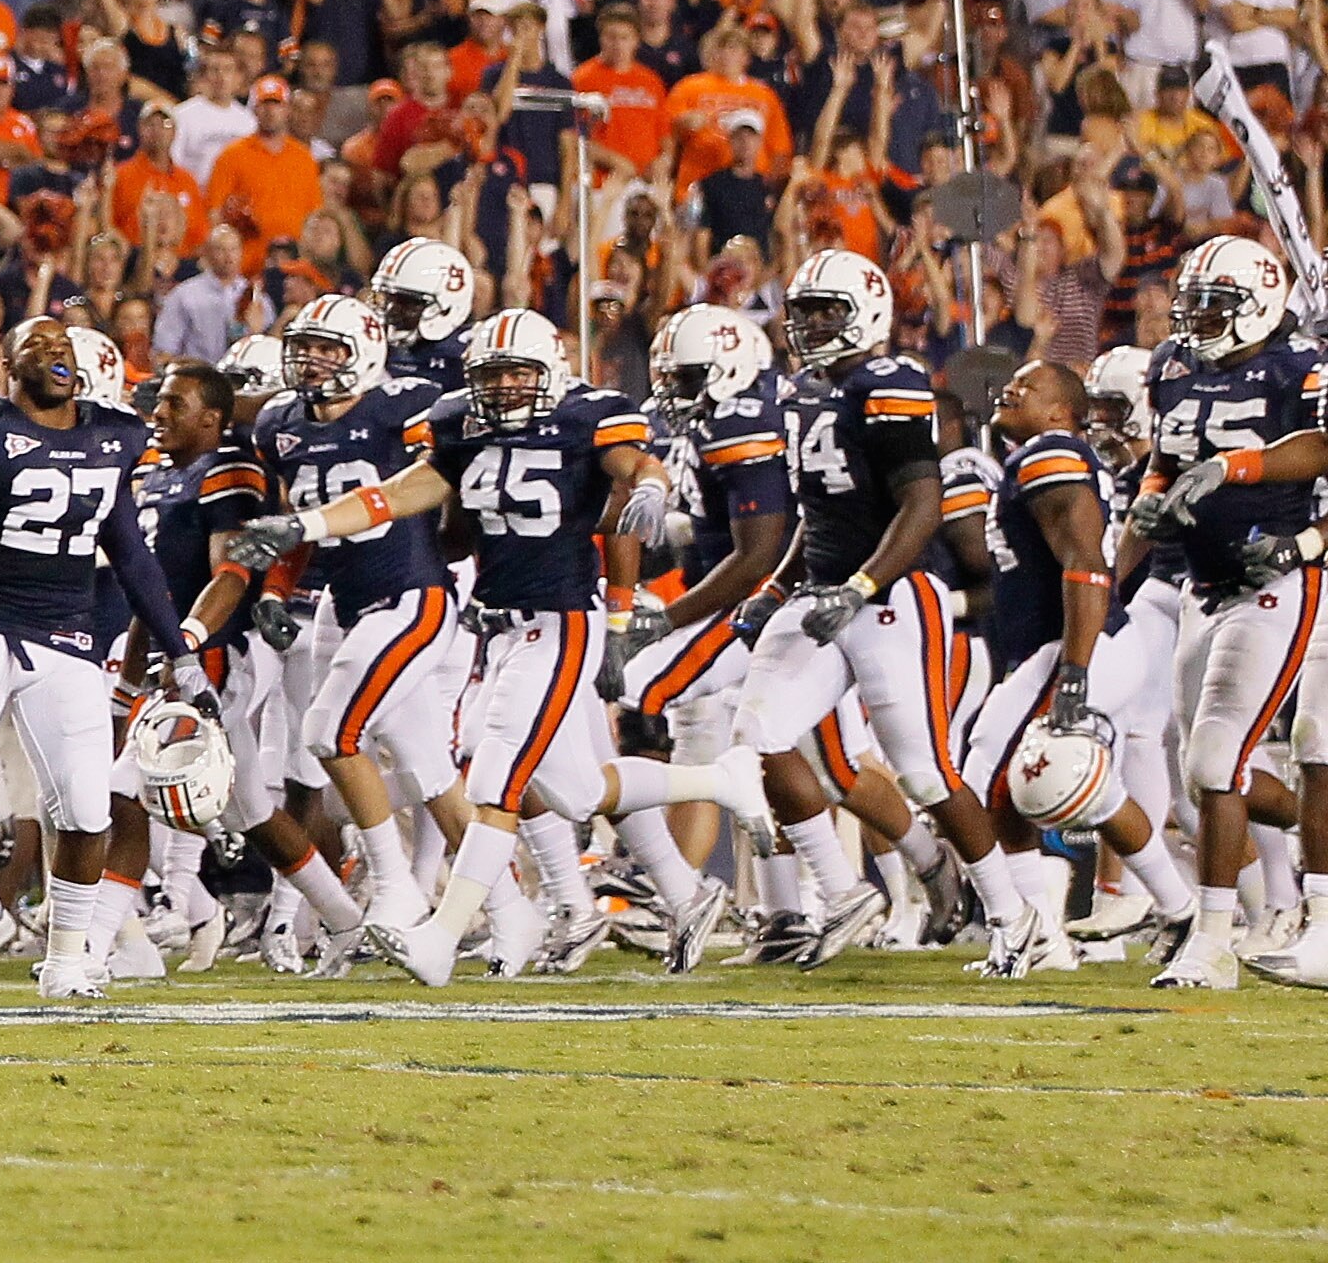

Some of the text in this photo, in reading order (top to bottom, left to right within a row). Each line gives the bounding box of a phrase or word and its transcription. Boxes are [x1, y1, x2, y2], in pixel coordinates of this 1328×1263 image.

[48, 450, 88, 461] AUBURN
[460, 446, 562, 538] 45
[0, 466, 122, 556] 27
